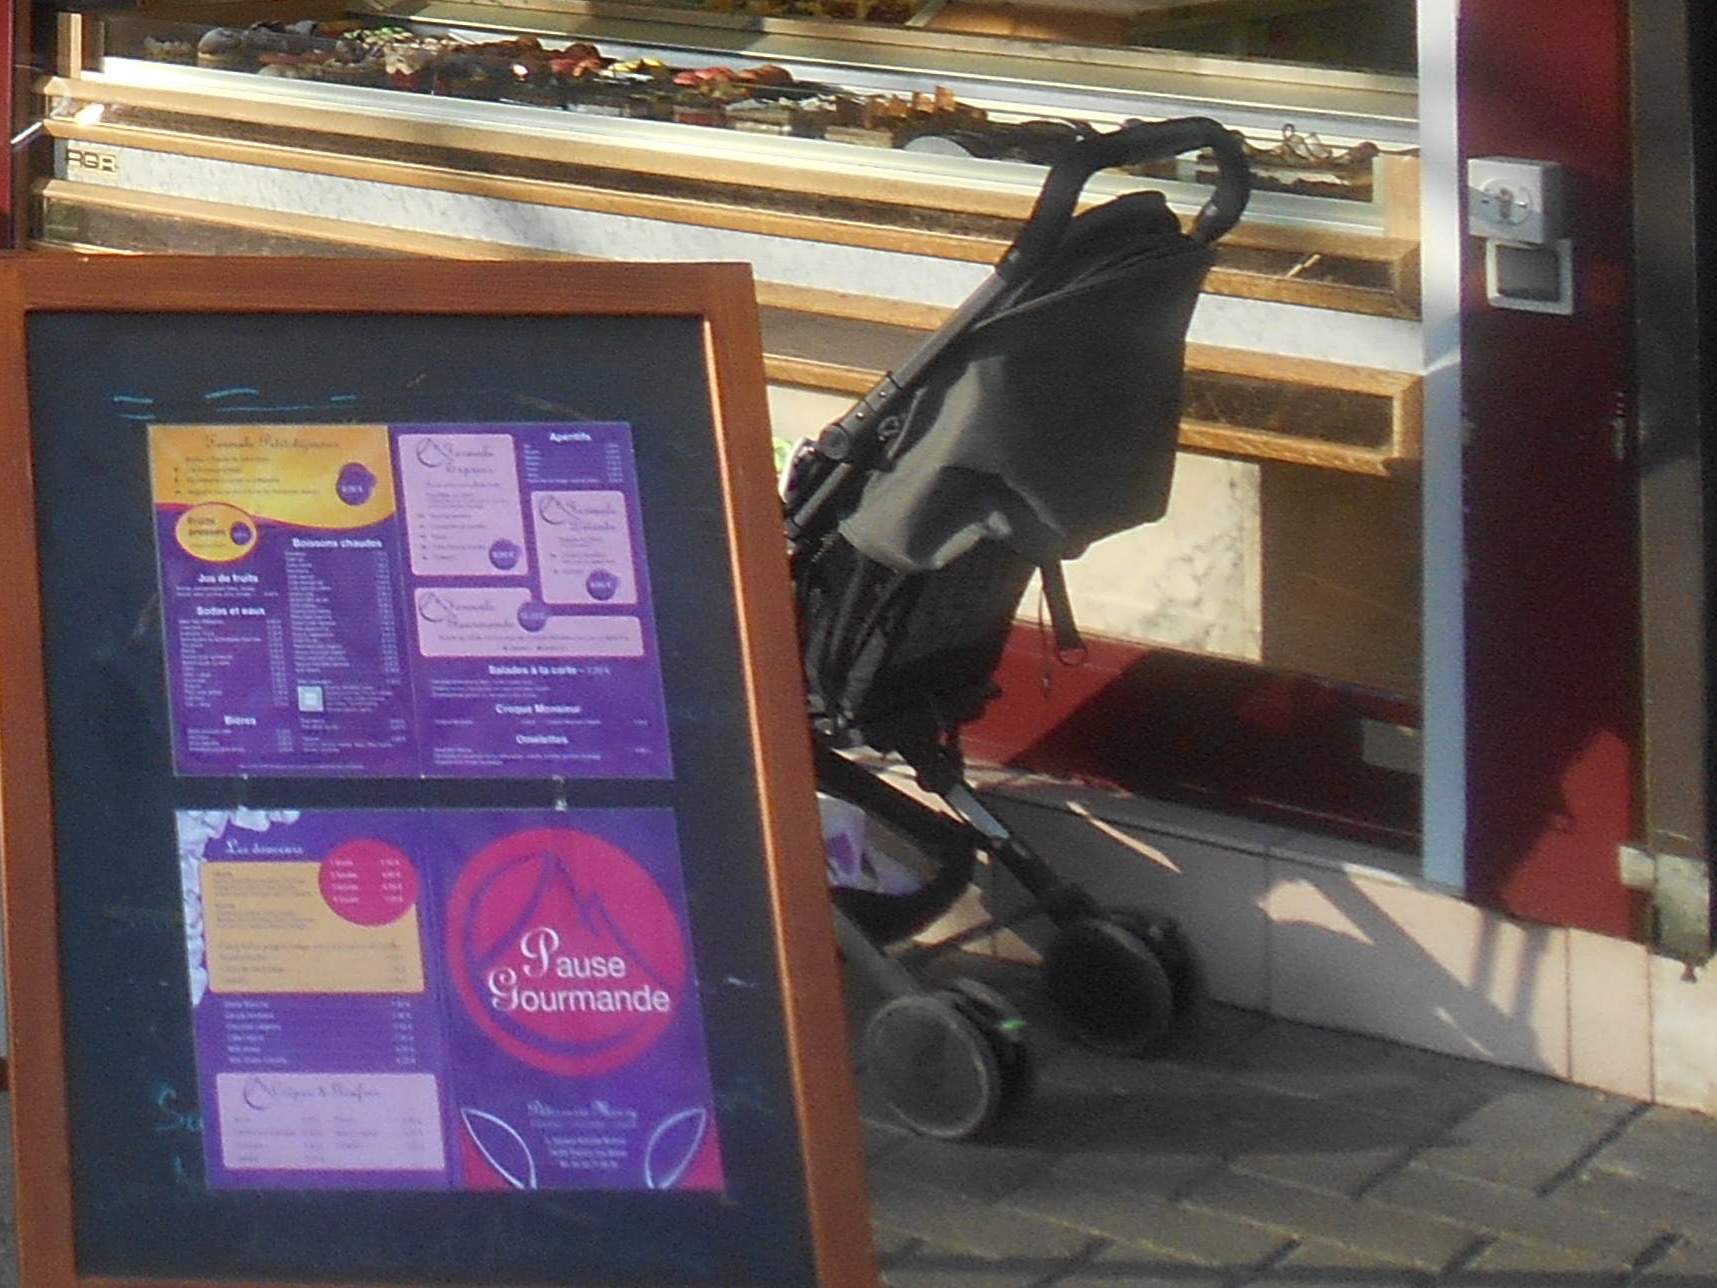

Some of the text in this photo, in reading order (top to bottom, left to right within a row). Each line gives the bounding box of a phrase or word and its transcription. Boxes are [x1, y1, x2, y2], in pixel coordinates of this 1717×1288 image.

[292, 538, 382, 549] Boissons chaudes
[218, 574, 231, 584] de
[233, 573, 259, 584] fruits
[520, 927, 626, 978] Pause
[488, 967, 671, 1012] Gourmande
